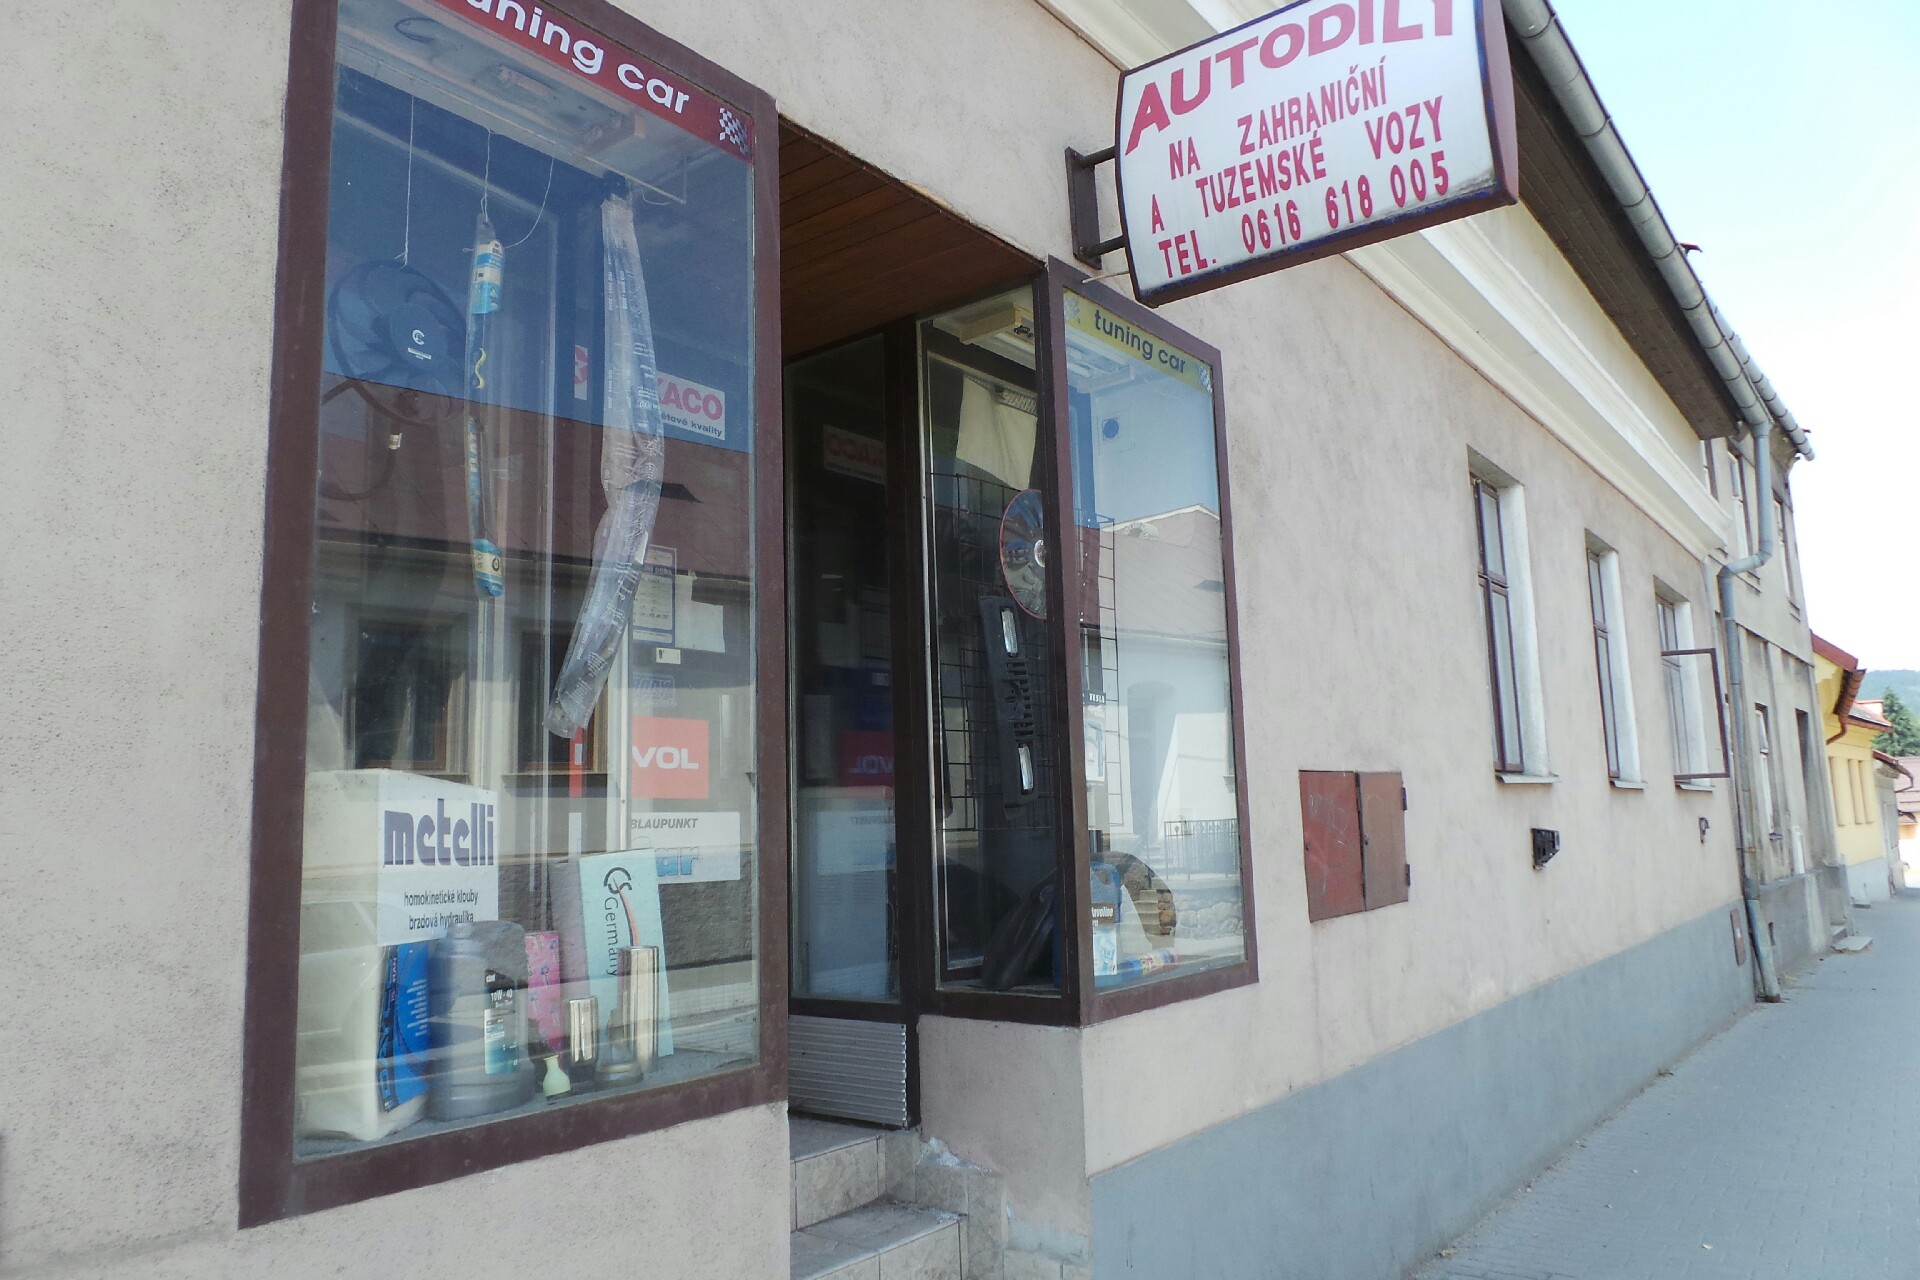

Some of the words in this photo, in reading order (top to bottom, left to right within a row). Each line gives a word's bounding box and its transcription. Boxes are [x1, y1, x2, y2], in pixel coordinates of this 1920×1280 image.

[617, 63, 689, 114] car
[1168, 136, 1200, 180] NA
[1237, 56, 1388, 155] ZAHRANIČNÍ
[1151, 194, 1165, 234] A
[1196, 130, 1326, 218] TUZEMSKÉ
[1364, 95, 1443, 160] VOZY
[1158, 229, 1217, 279] TEL.
[1240, 200, 1301, 254] 0616
[1325, 174, 1374, 229] 618
[1389, 151, 1449, 208] 005
[1094, 309, 1154, 361] tuning
[1158, 348, 1186, 374] car
[691, 420, 723, 437] kvality
[384, 798, 494, 867] metelli
[631, 817, 698, 830] BLAUPUNKT
[456, 889, 479, 906] klouby
